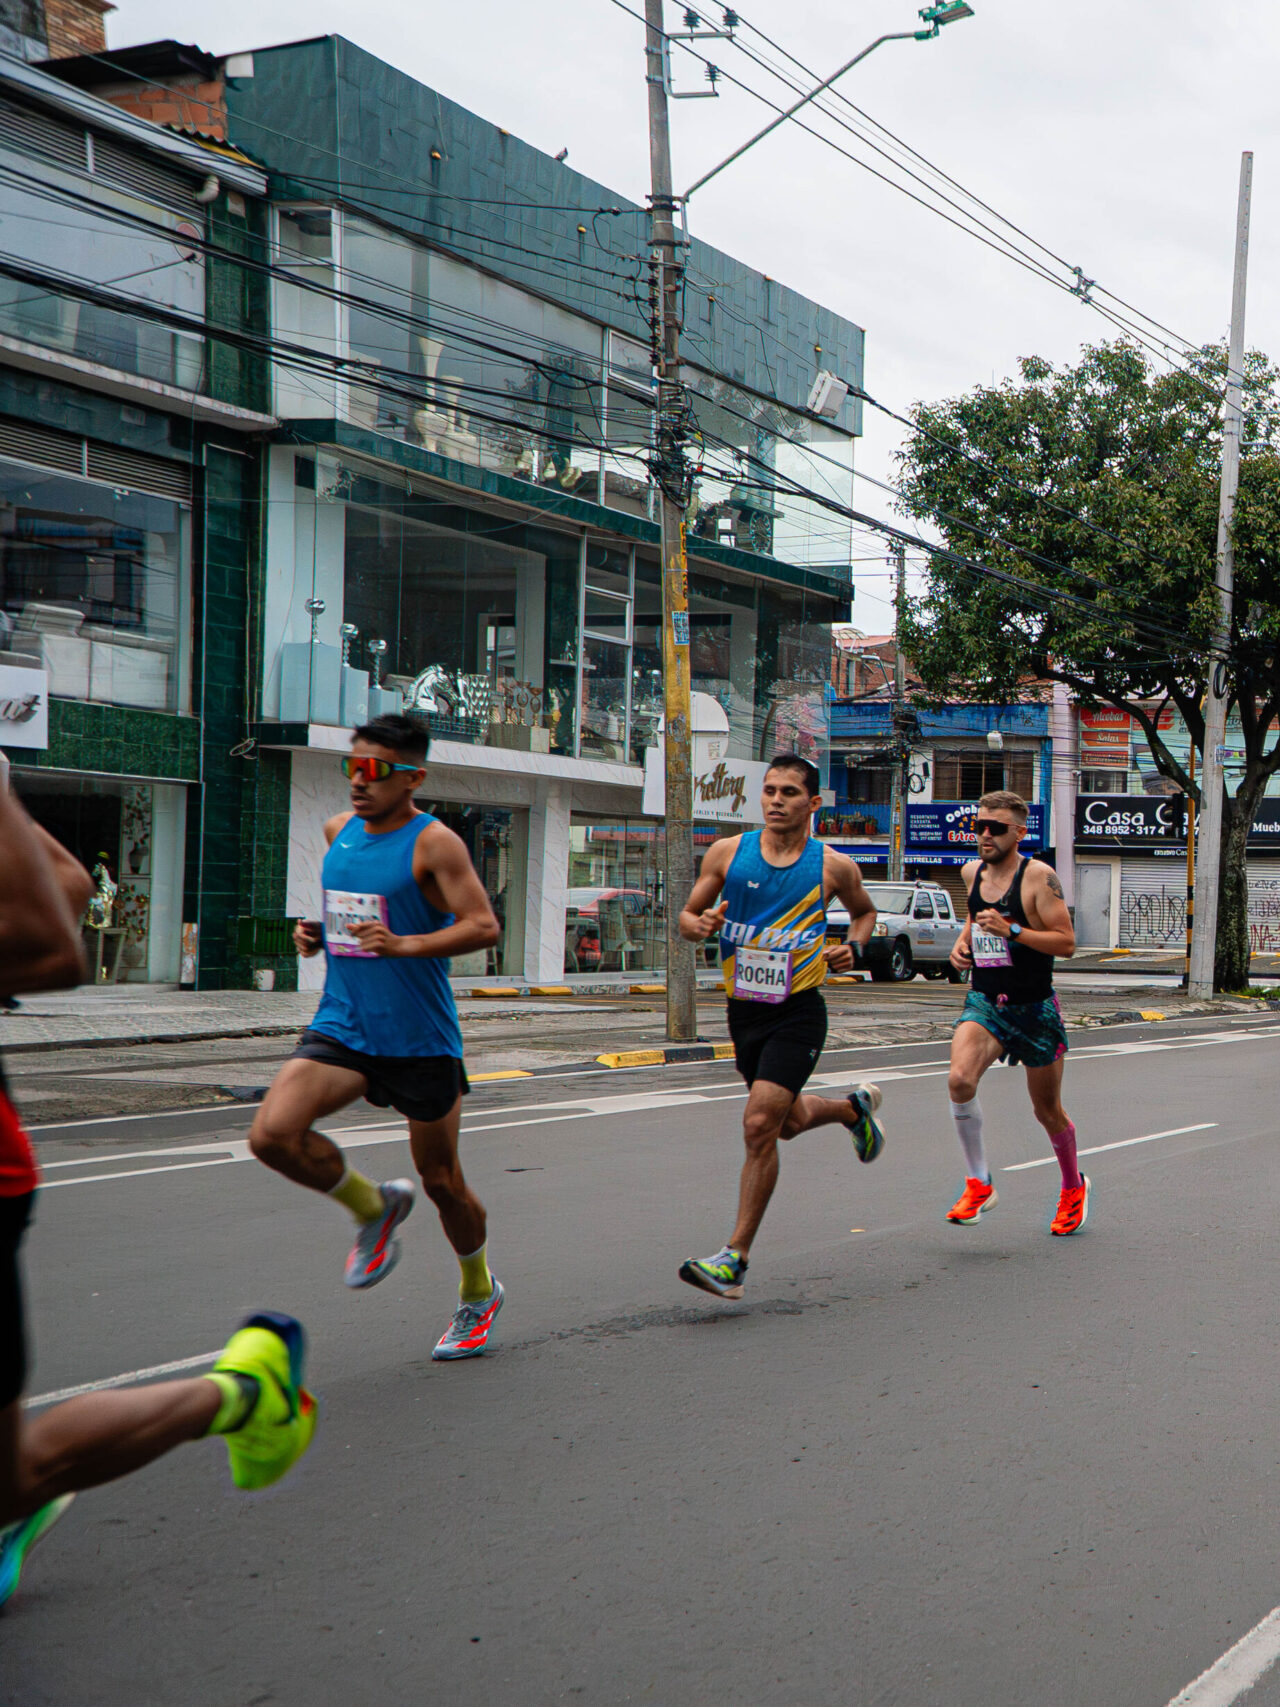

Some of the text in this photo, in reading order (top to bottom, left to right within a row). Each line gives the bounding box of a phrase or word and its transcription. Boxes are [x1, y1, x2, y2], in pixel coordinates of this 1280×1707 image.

[1085, 801, 1144, 826] Casa
[948, 830, 978, 842] Estre
[1083, 825, 1103, 835] 348
[851, 855, 878, 863] CHONES
[736, 963, 786, 987] ROCHA
